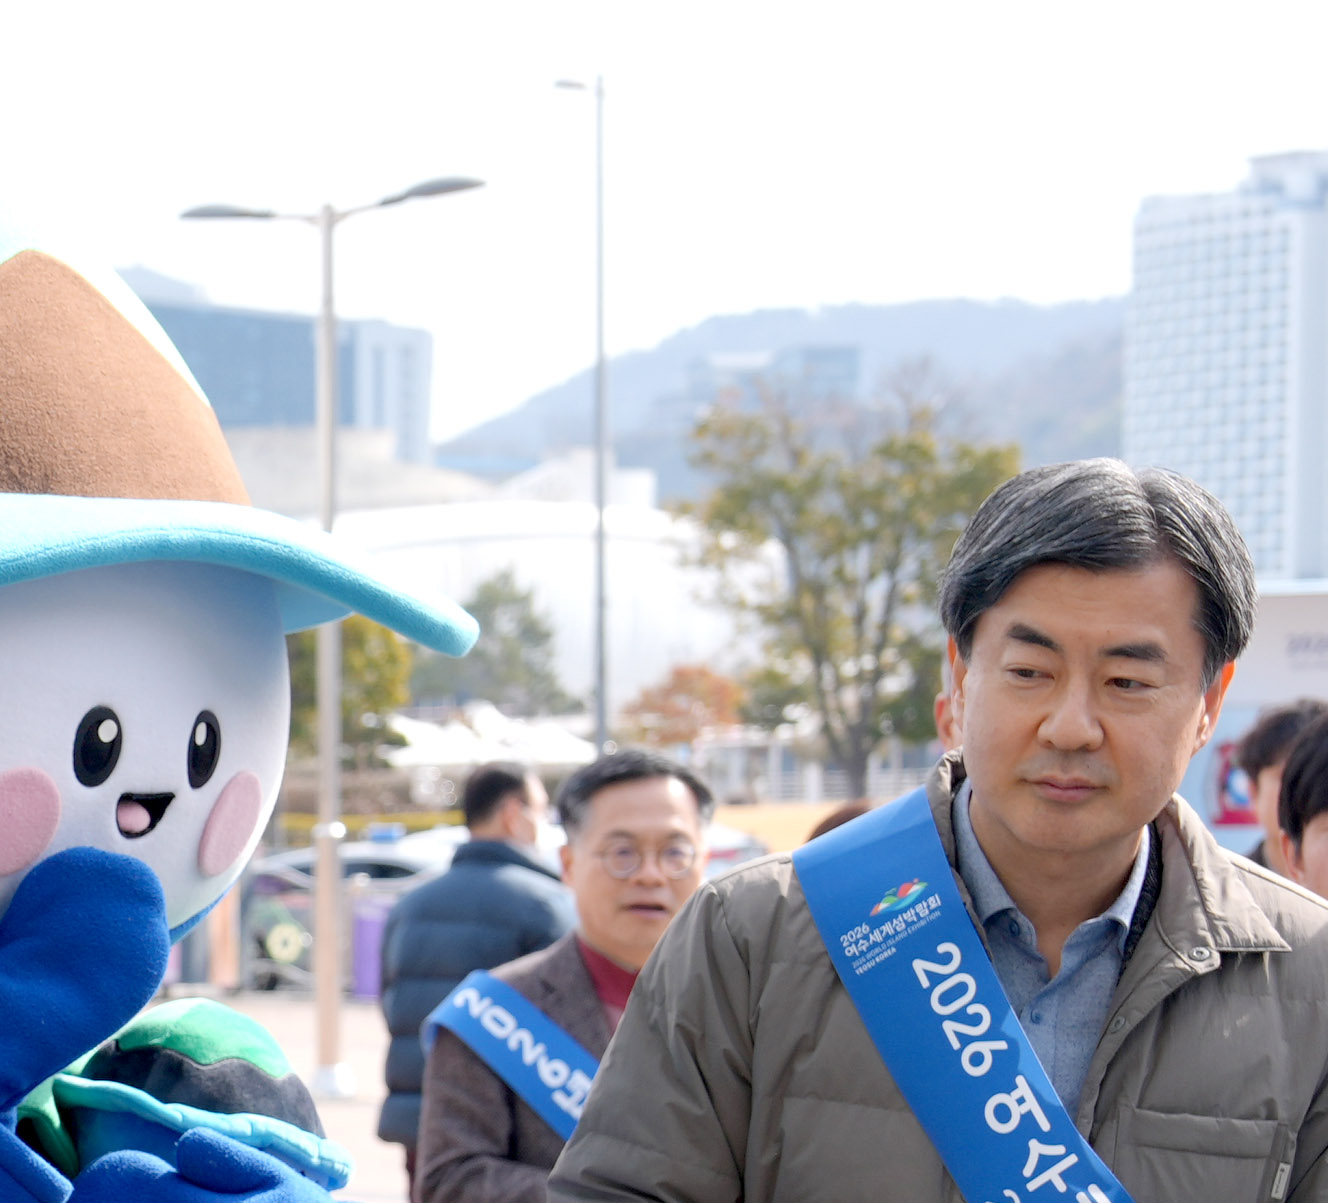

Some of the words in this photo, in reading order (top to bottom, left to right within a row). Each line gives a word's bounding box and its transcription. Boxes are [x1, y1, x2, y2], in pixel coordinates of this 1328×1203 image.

[840, 922, 870, 947] 2026
[845, 894, 942, 957] 여수세계섬박람회
[875, 946, 896, 963] KOREA
[911, 941, 1008, 1077] 2026
